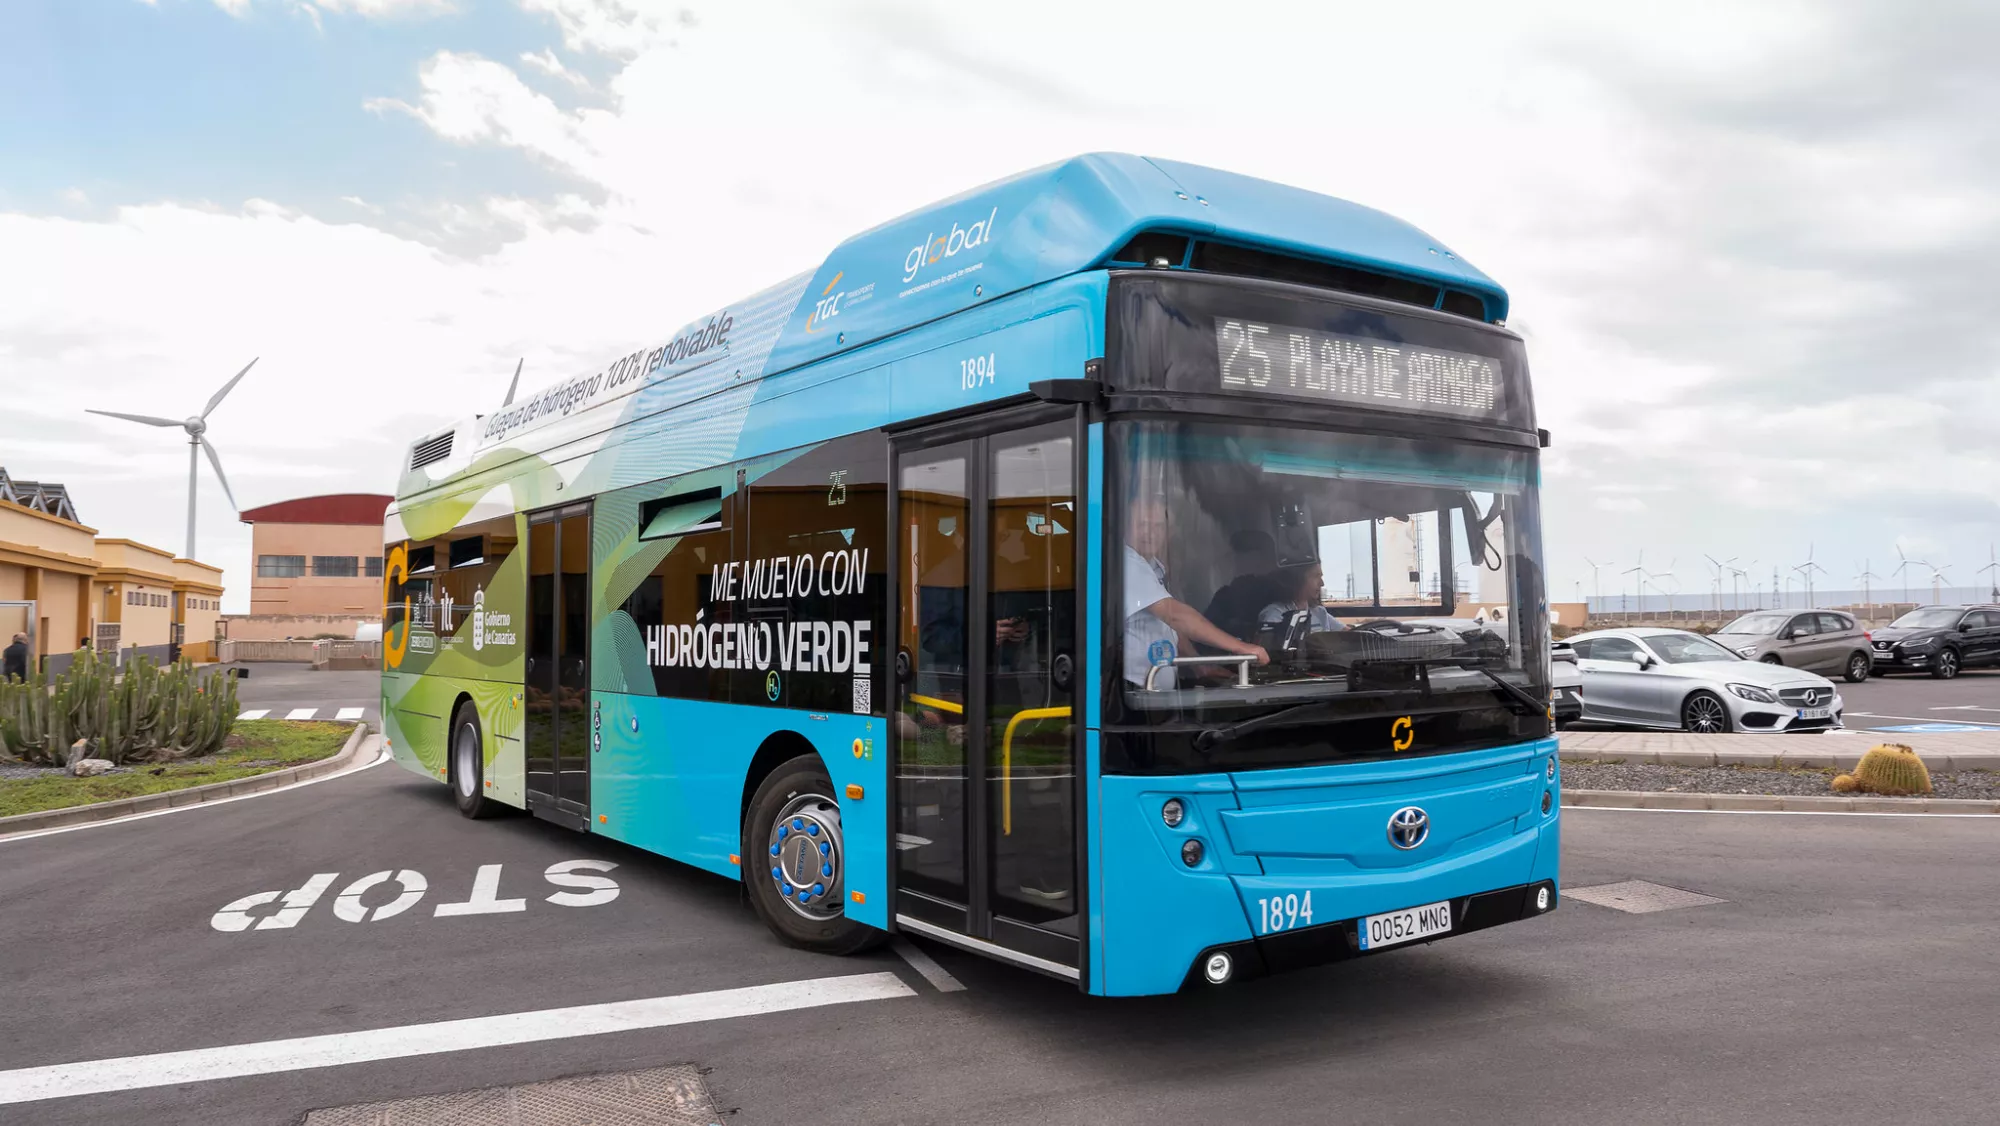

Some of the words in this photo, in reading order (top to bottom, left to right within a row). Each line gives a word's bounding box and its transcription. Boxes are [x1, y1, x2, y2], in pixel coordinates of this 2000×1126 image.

[903, 206, 998, 283] global
[814, 291, 845, 324] TGC
[484, 406, 525, 440] Guagua
[522, 395, 540, 424] de
[537, 372, 603, 416] hidrógeno
[603, 348, 647, 391] 100%
[641, 311, 734, 376] renovable
[960, 352, 995, 391] 1894
[1223, 321, 1271, 387] 25
[1289, 334, 1367, 394] PLAYA
[1372, 346, 1402, 398] DE
[1407, 352, 1494, 410] ARINAGA
[828, 470, 848, 506] 25
[710, 561, 740, 602] ME
[741, 553, 814, 600] MUEVO
[818, 548, 869, 596] CON
[484, 611, 511, 626] Gobierno
[484, 629, 491, 644] de
[491, 630, 516, 645] Canarias
[646, 608, 772, 671] HIDRÓGENO
[777, 620, 871, 674] VERDE
[210, 859, 621, 932] STOP
[1258, 890, 1313, 932] 1894
[1372, 913, 1415, 943] 0052
[1418, 906, 1448, 933] MNG
